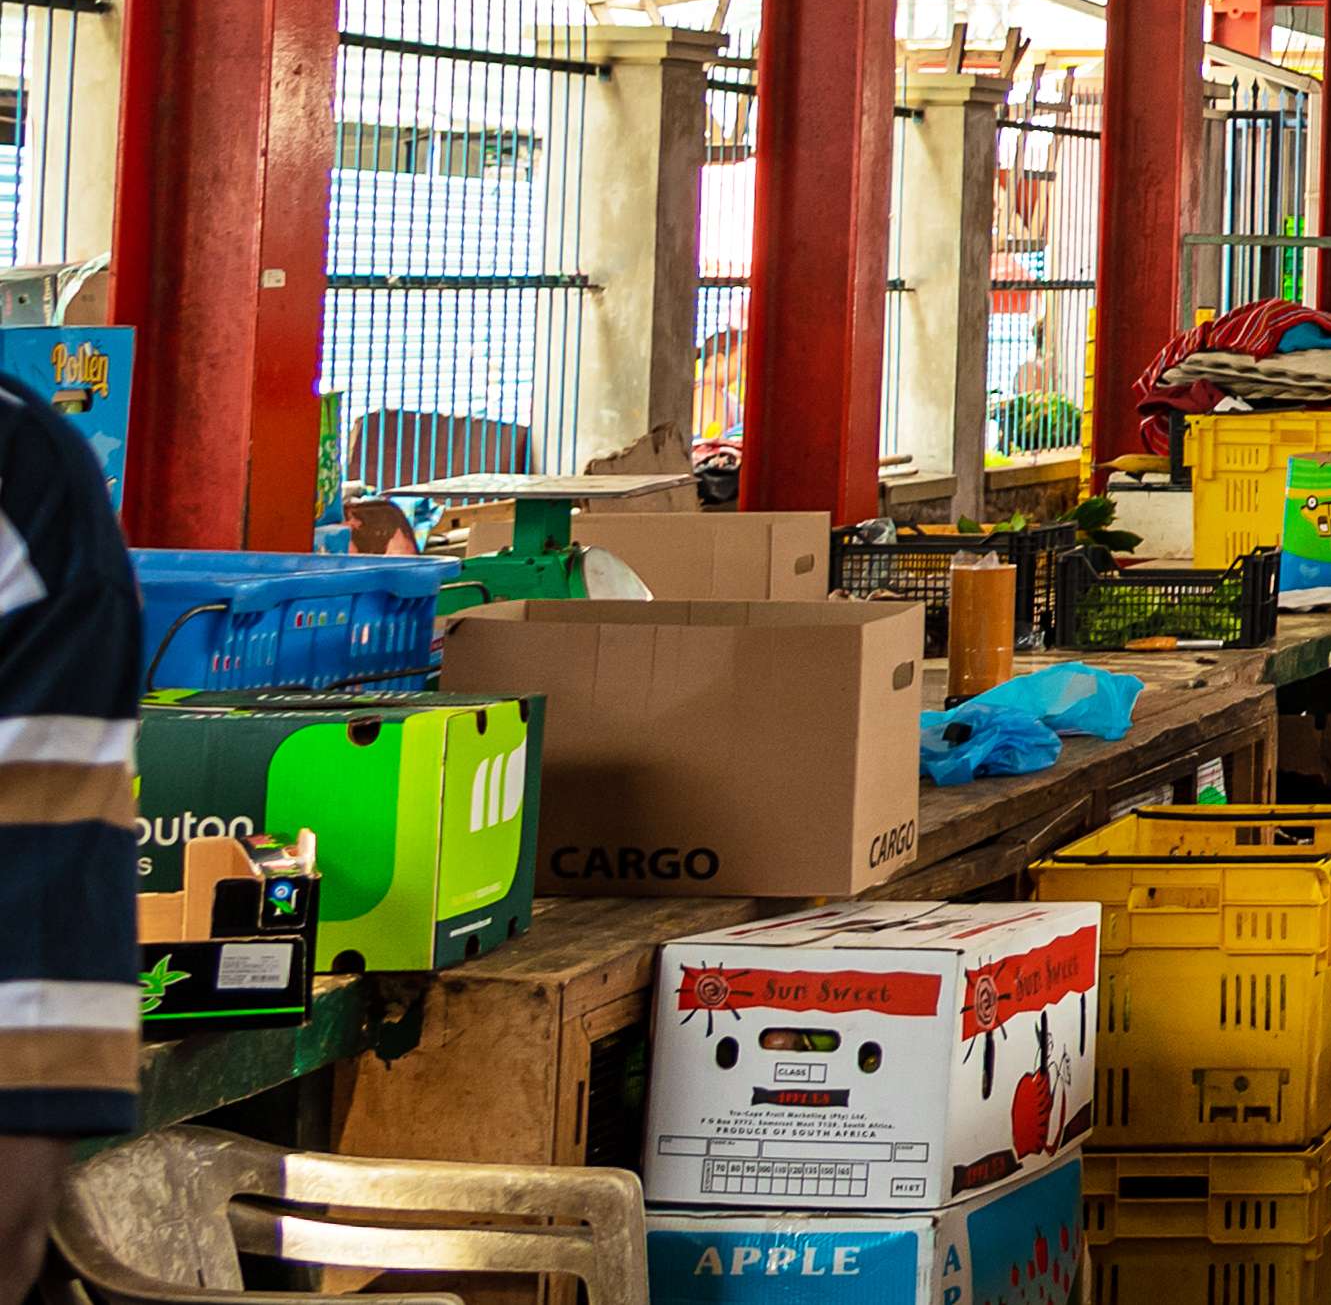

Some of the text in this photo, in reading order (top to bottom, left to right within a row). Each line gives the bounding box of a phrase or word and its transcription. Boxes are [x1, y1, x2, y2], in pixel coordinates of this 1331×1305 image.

[869, 819, 915, 869] CARGO
[550, 846, 720, 880] CARGO
[764, 979, 892, 1003] Sun Sweet
[1014, 955, 1079, 1003] Sun Sweet
[778, 1068, 807, 1077] CLASS
[716, 1126, 767, 1134] PRODUCE
[792, 1128, 830, 1136] SOUTH
[834, 1130, 877, 1138] AFRICA
[693, 1246, 861, 1277] APPLE
